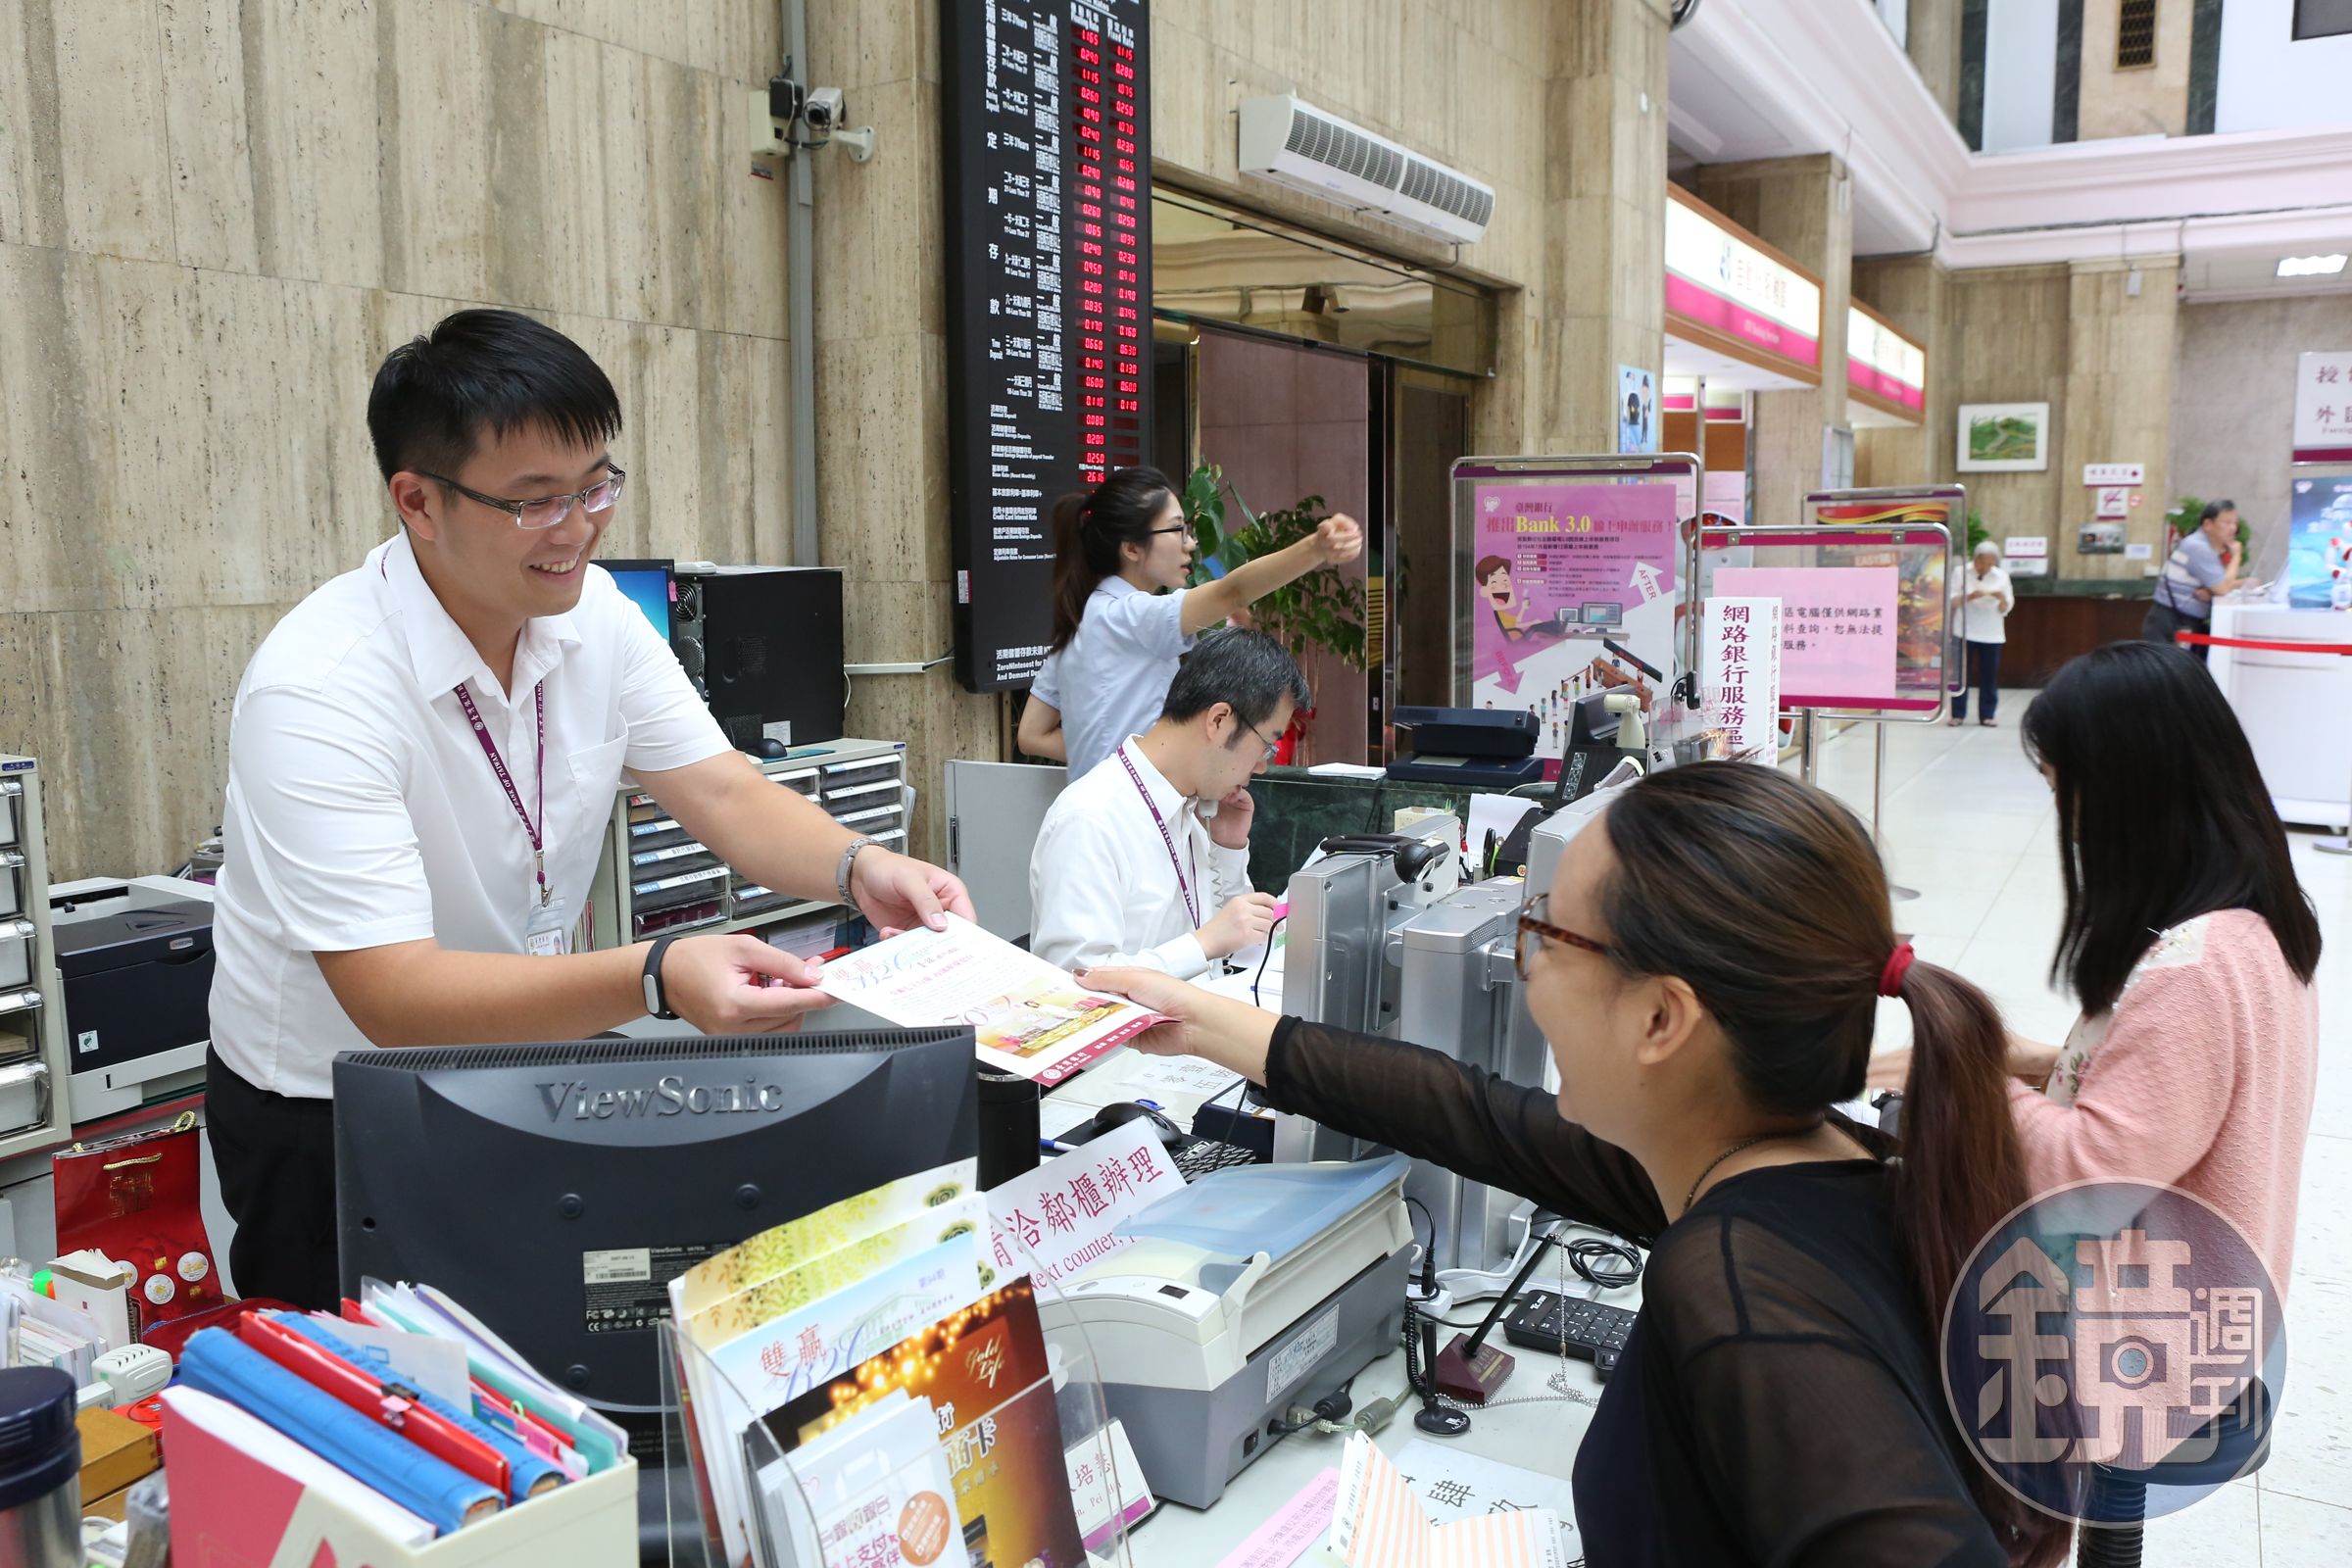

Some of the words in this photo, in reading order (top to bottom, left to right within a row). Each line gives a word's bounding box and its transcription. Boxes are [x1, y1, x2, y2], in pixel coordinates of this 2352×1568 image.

[1516, 515, 1560, 533] Bank
[1565, 515, 1592, 533] 3.0
[1639, 569, 1656, 600] AFTER
[1720, 605, 1750, 746] 網路銀行服務區
[489, 752, 505, 778] TAIWAN
[535, 1076, 783, 1122] ViewSonic
[1063, 1231, 1124, 1272] counter,
[760, 1323, 827, 1377] 雙贏
